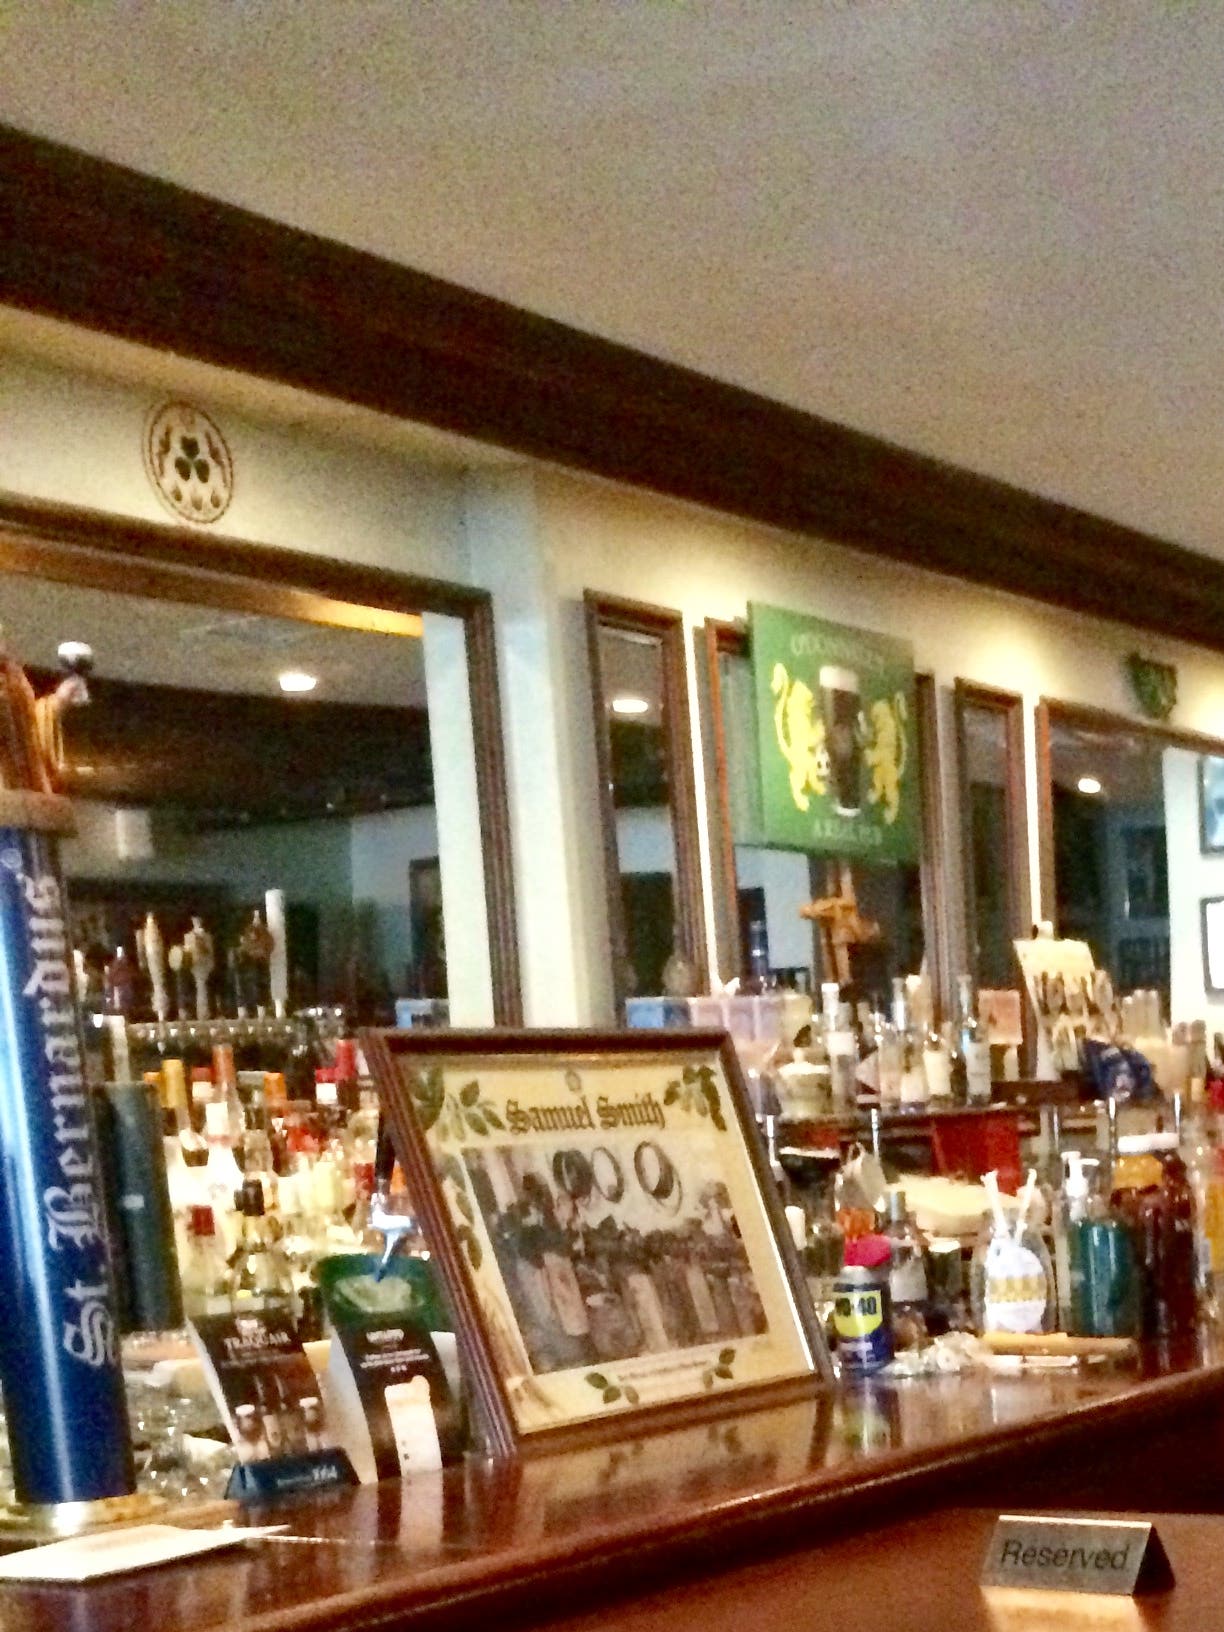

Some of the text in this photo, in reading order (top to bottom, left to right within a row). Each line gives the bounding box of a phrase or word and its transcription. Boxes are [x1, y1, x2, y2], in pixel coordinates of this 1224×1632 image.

[21, 875, 101, 1250] Bernardus
[597, 1093, 665, 1130] Smith
[1000, 1538, 1130, 1571] Reserved
